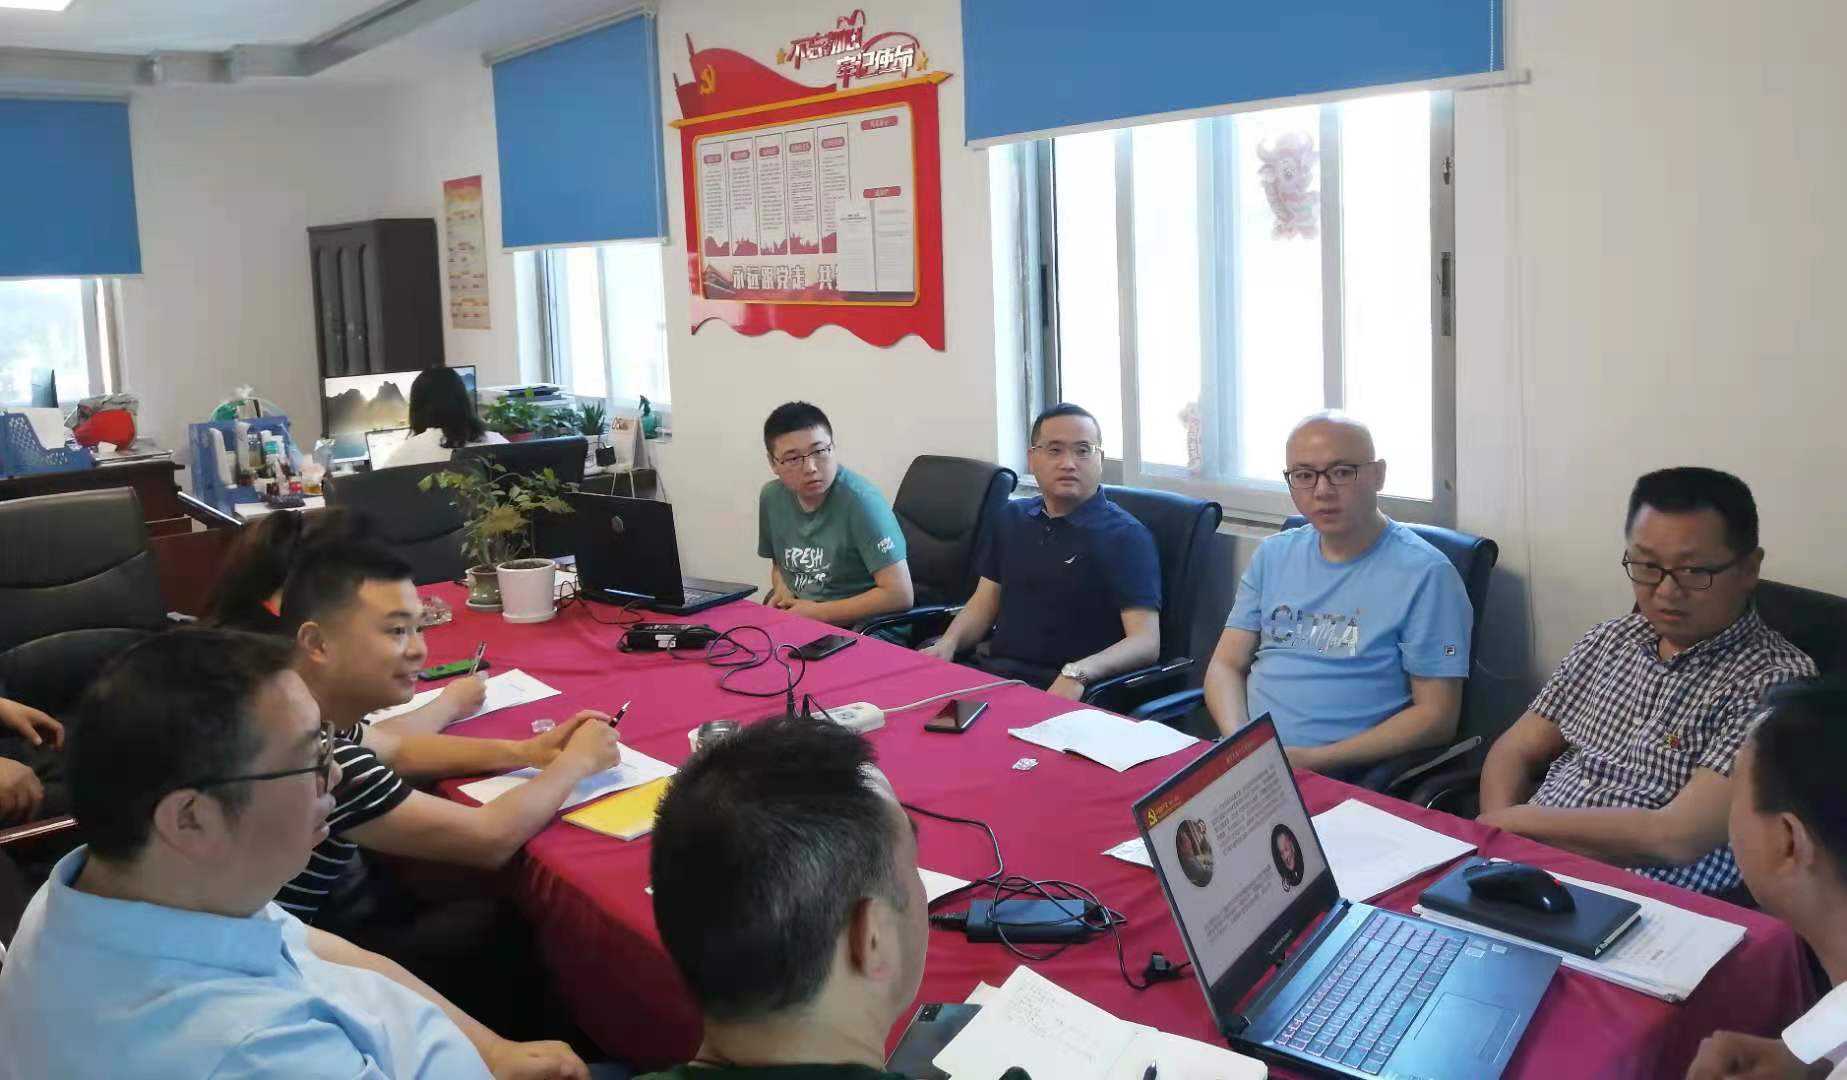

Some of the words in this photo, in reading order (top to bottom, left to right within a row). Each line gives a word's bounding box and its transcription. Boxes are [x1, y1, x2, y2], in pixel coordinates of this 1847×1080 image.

[732, 264, 806, 290] 永远跟党走
[784, 547, 824, 568] FRESH
